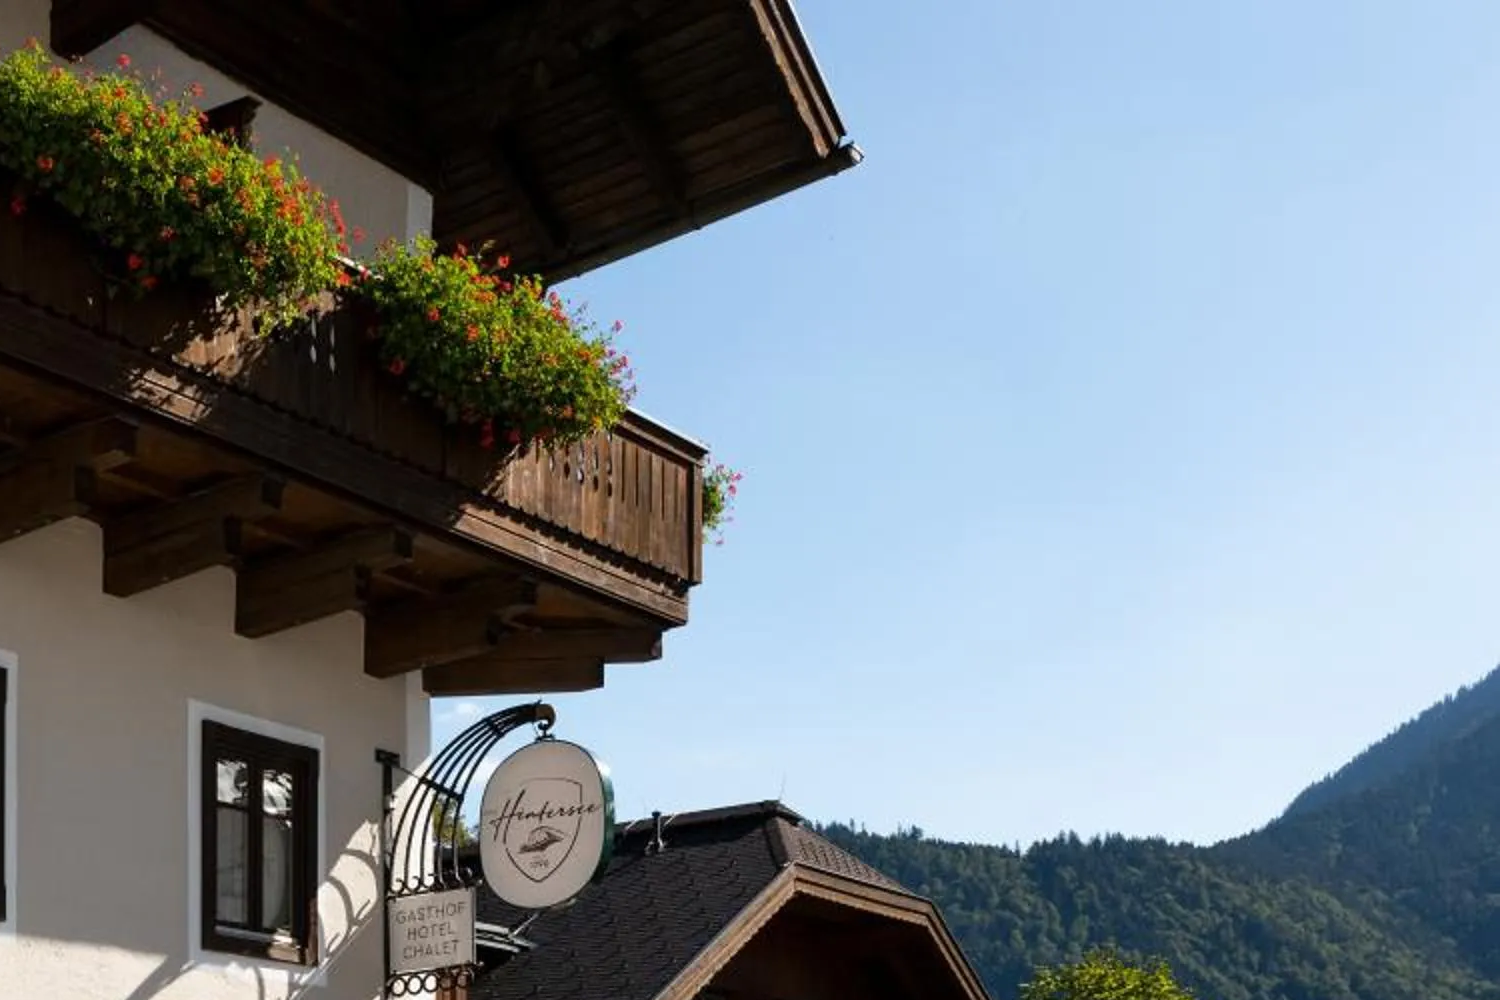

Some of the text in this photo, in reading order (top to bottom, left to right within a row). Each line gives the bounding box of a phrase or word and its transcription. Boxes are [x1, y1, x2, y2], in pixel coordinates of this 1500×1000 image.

[489, 789, 601, 844] Hintersee
[396, 902, 466, 924] GASTHOF
[407, 921, 456, 941] HOTEL
[403, 939, 459, 959] CHALET
